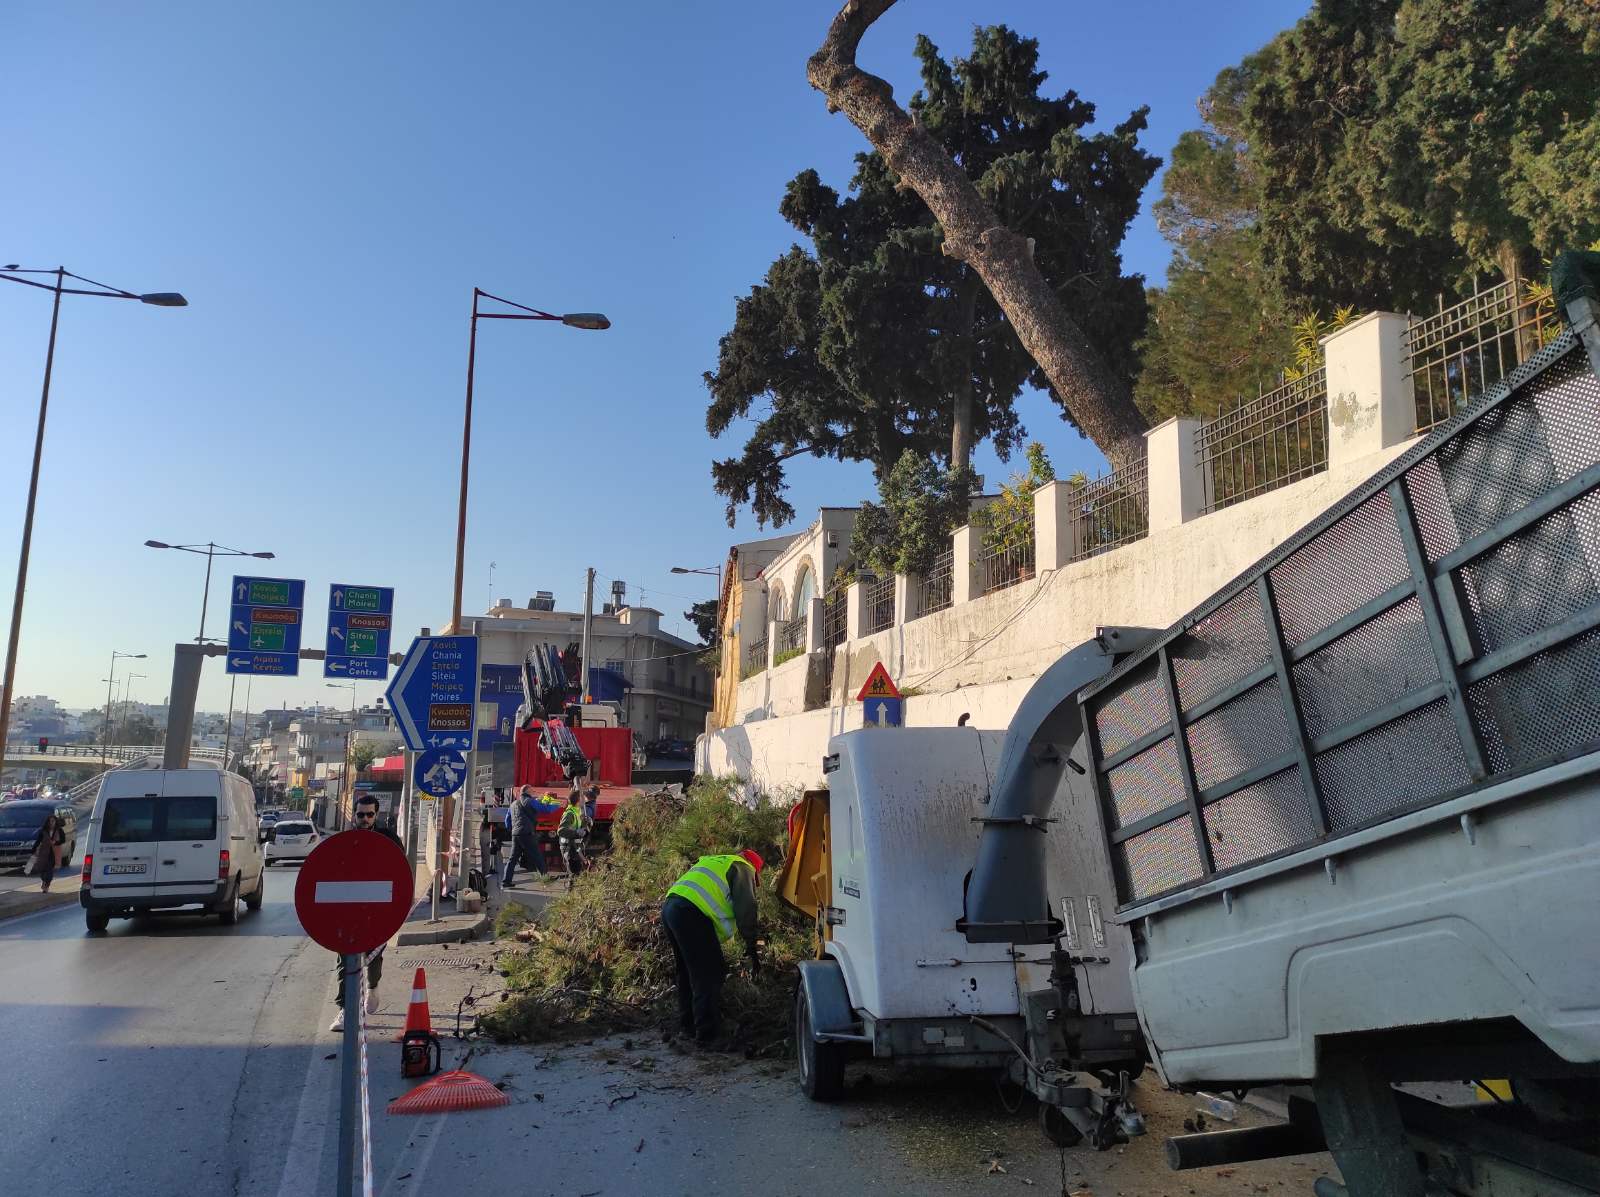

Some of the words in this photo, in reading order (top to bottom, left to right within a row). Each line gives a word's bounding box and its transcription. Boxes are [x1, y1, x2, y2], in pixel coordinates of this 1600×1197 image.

[349, 591, 377, 600] Chania
[349, 599, 376, 607] Moires
[351, 617, 385, 626] Knossos
[432, 650, 462, 659] Chania
[349, 668, 378, 676] Centre
[431, 671, 456, 680] Siteia
[431, 692, 460, 701] Moires
[431, 717, 466, 727] Knossos
